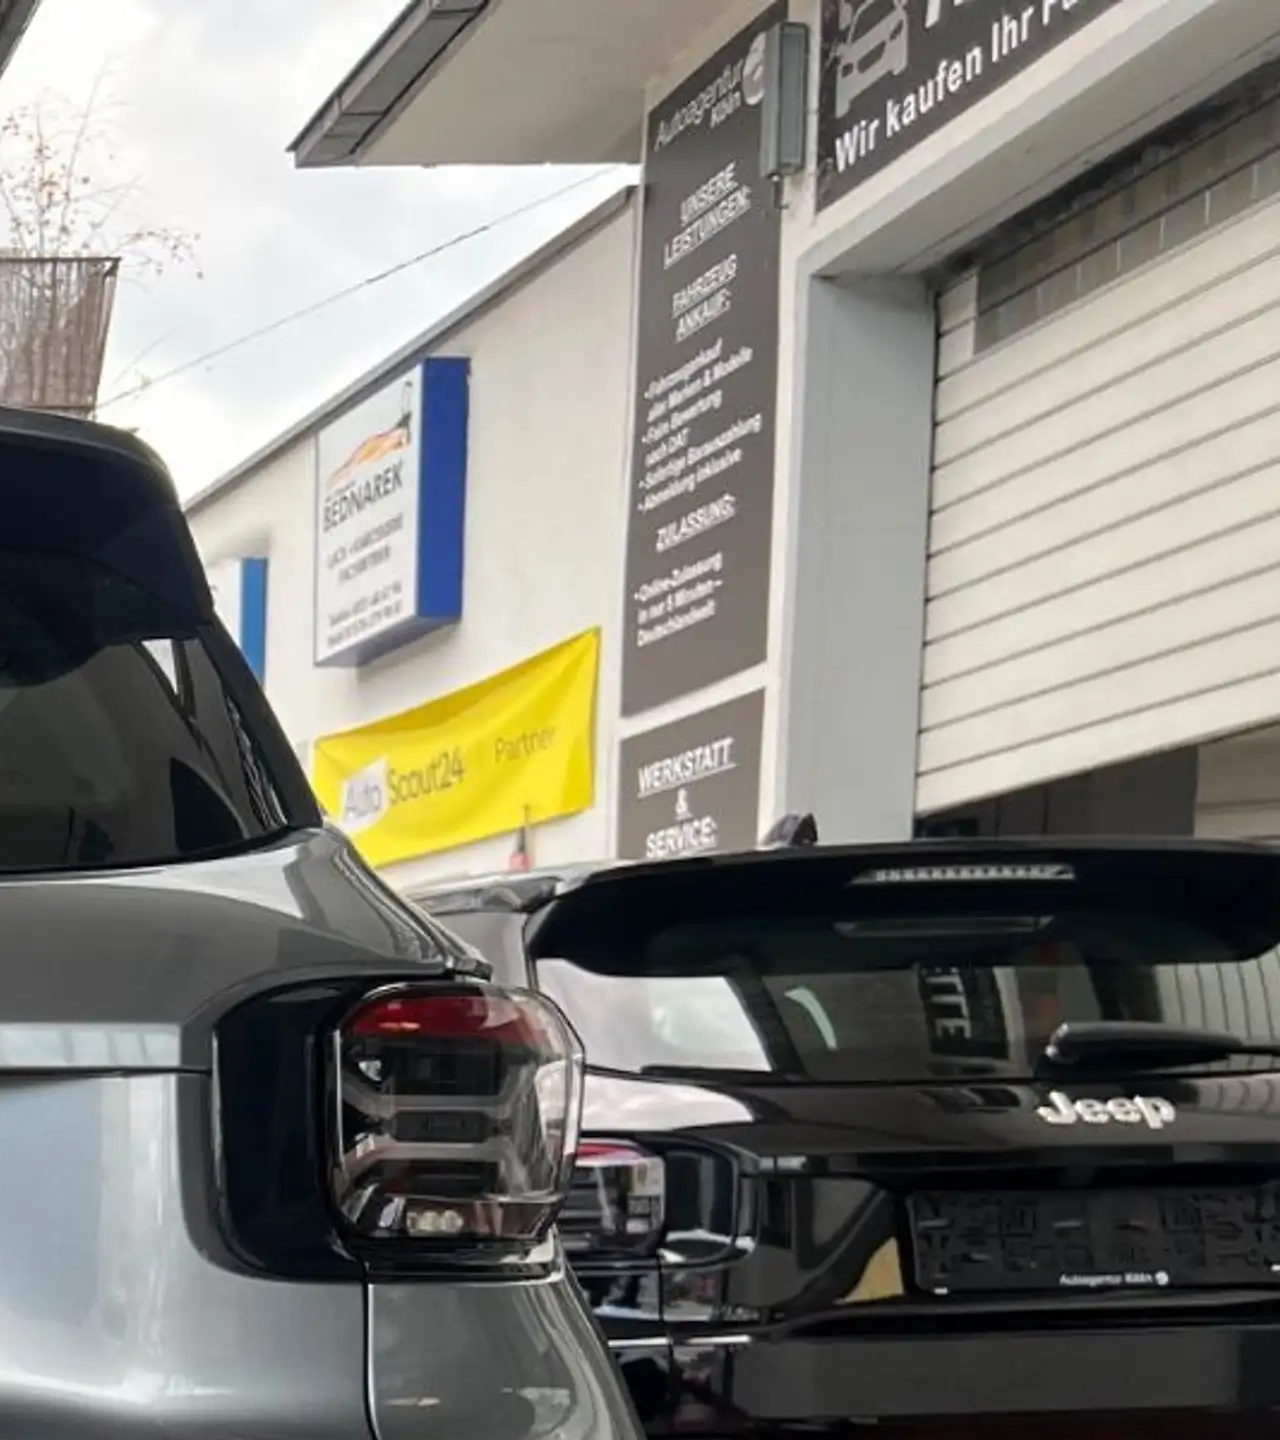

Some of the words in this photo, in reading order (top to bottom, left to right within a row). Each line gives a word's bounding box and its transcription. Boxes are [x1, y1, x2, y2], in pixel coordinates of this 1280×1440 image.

[835, 117, 880, 172] Wir
[886, 46, 982, 138] kaufen
[991, 5, 1035, 63] Ihr
[494, 726, 557, 765] Partner
[638, 737, 735, 794] WERKSTATT
[675, 788, 688, 814] &
[1036, 1090, 1176, 1129] Jeep
